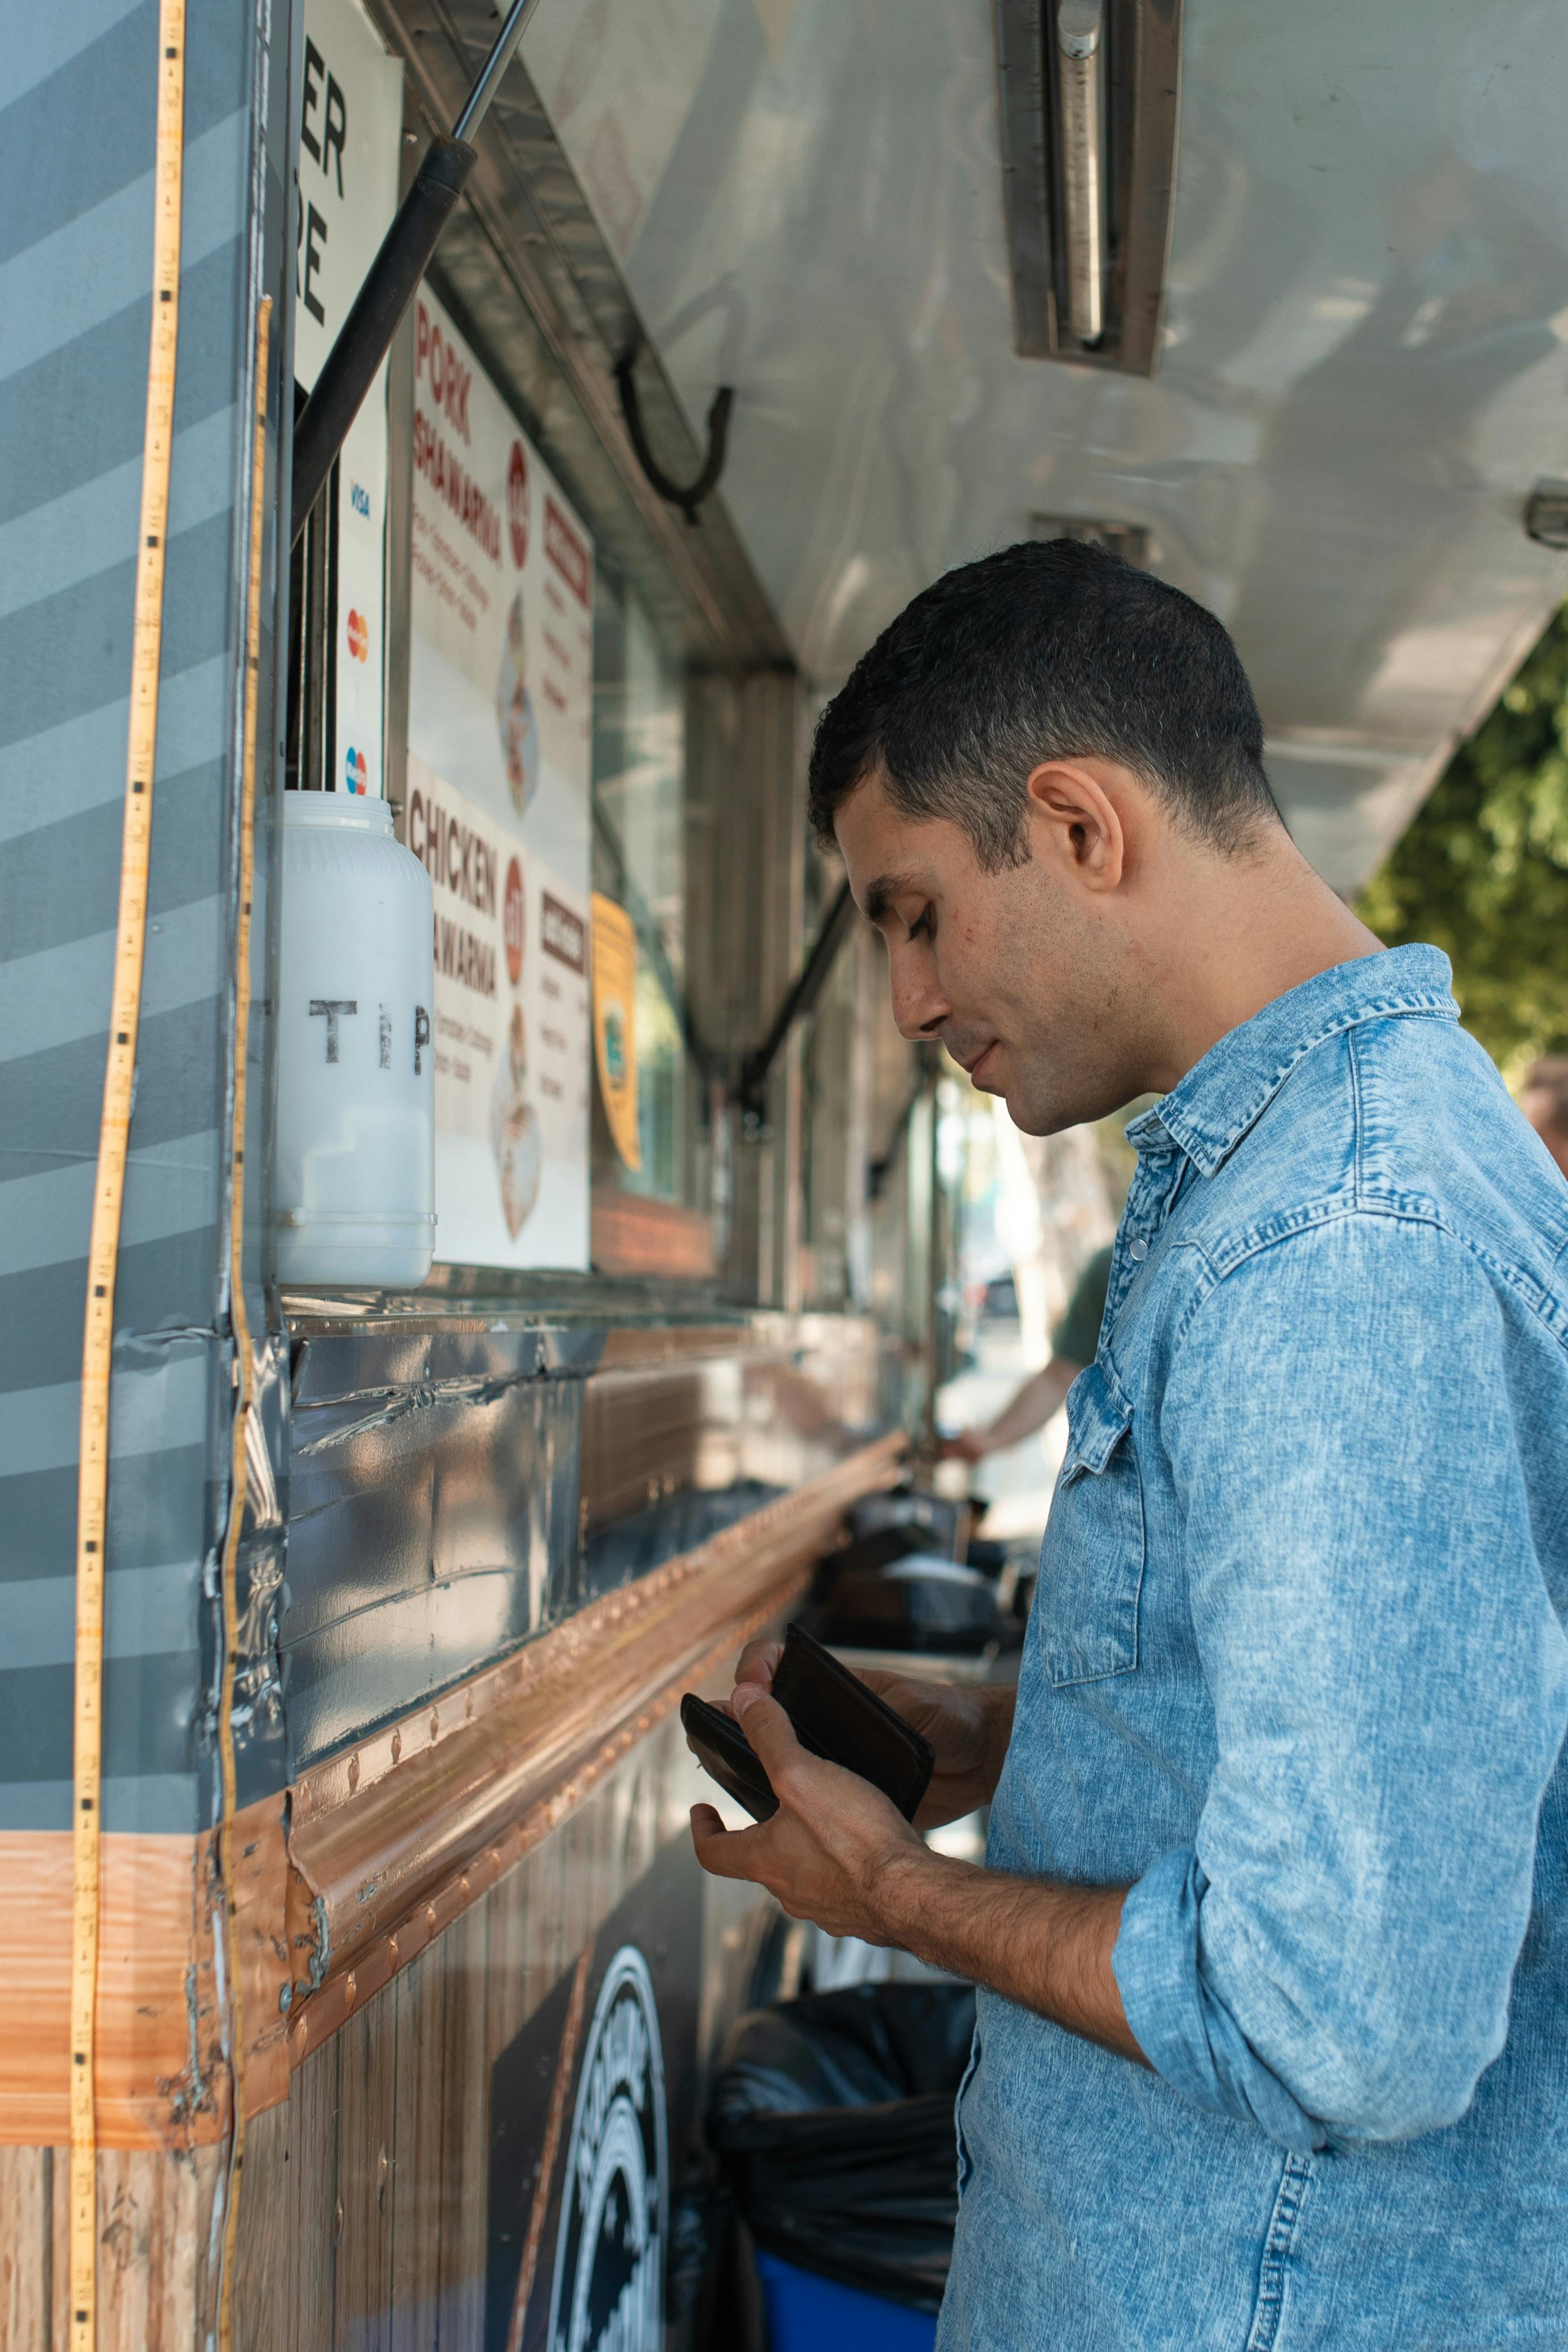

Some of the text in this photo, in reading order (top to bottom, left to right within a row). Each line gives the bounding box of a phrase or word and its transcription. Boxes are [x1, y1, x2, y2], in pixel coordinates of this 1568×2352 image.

[415, 298, 472, 448] PORK
[351, 482, 369, 521] VISA
[411, 789, 498, 918] CHICKEN
